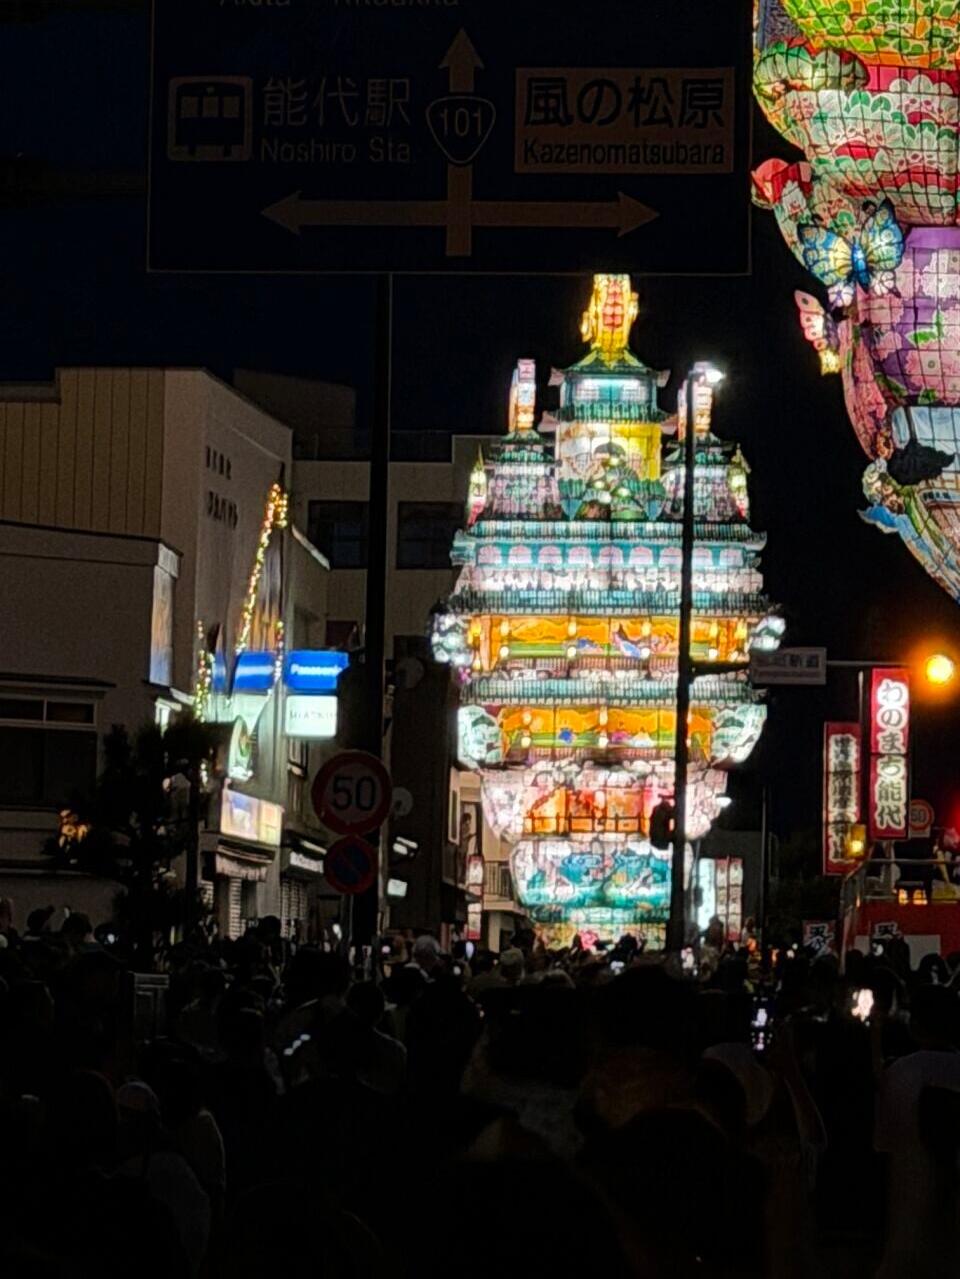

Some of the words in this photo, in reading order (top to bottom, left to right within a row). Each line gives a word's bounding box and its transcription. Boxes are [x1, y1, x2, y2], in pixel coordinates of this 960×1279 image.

[260, 75, 412, 128] 能代駅
[523, 77, 725, 128] 風の松原
[439, 107, 484, 138] 101
[259, 137, 357, 163] Noshiro
[523, 138, 725, 166] Kazenomatsubara
[879, 682, 906, 827] わのまち能代
[333, 775, 375, 811] 50
